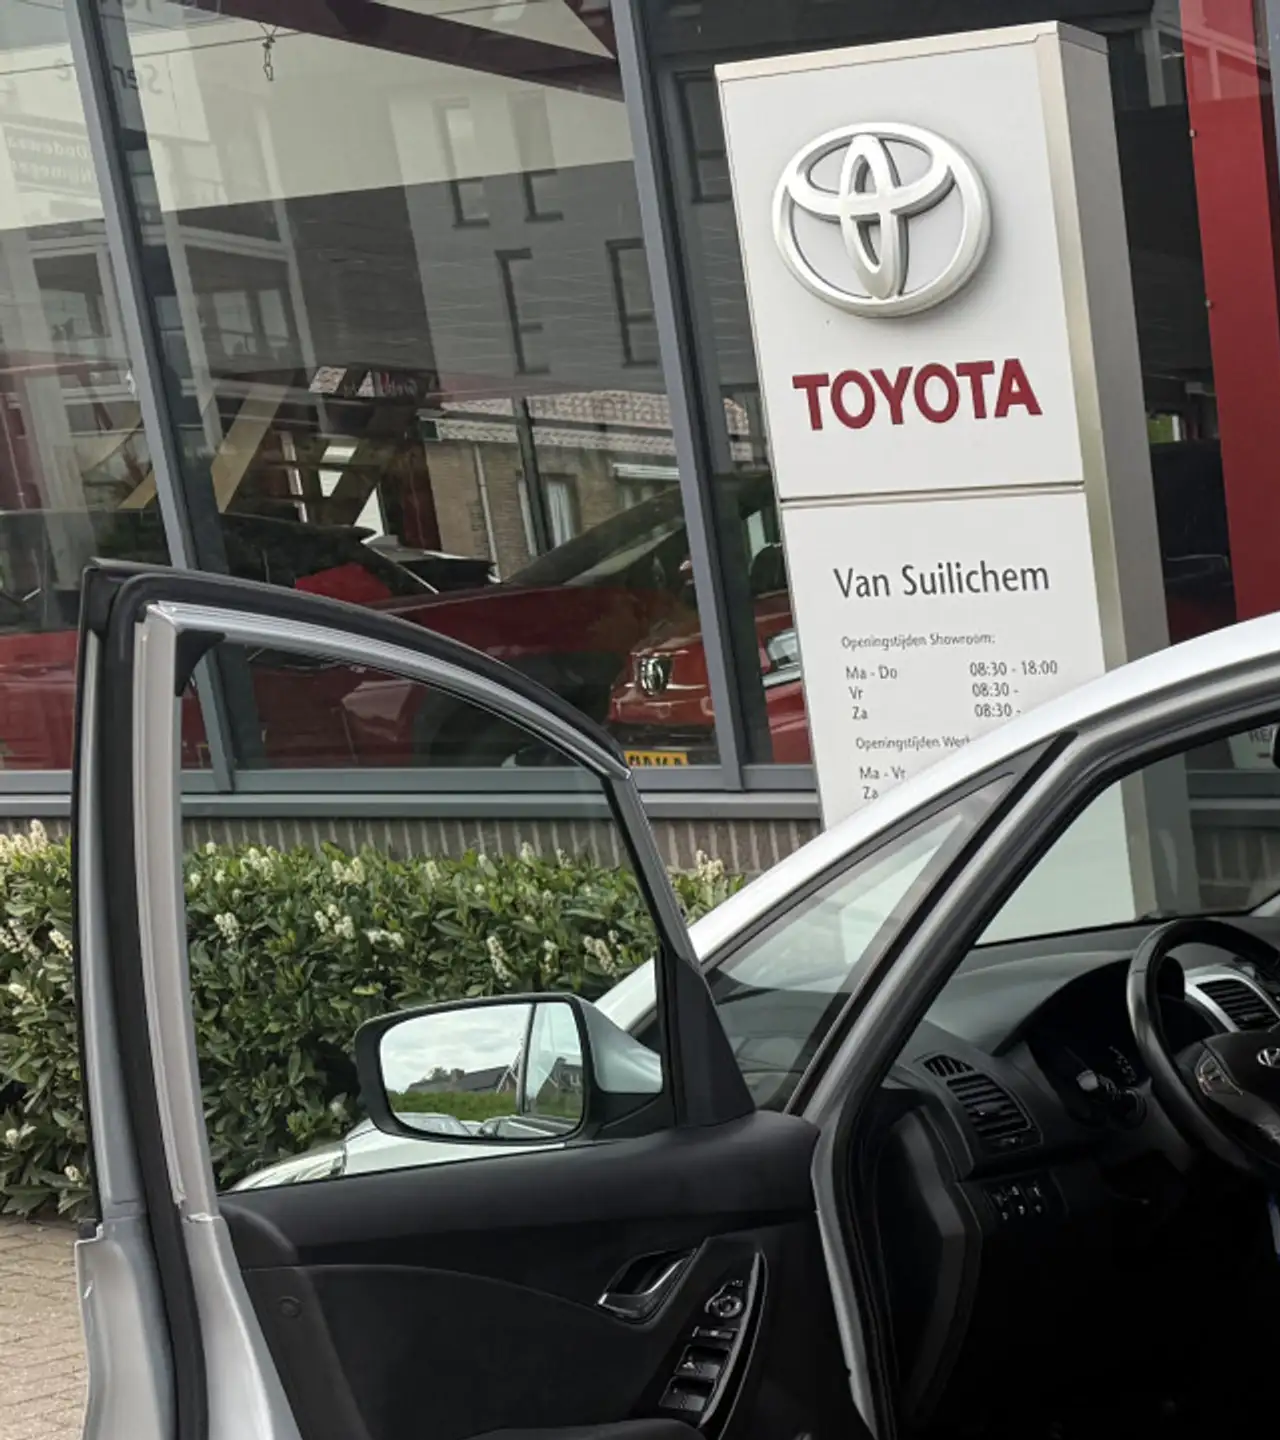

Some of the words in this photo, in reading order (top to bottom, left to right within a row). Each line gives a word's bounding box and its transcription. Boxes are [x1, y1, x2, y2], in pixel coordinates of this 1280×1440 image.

[792, 358, 1042, 431] TOYOTA
[832, 567, 891, 599] Van
[901, 560, 1050, 597] Suilichem
[841, 634, 927, 651] Openingstijden
[846, 665, 868, 681] Ma
[878, 664, 898, 680] Do
[969, 661, 1008, 677] 08:30
[1021, 659, 1058, 676] 18:00
[849, 685, 864, 700] Vr
[972, 681, 1010, 698] 08:30
[852, 706, 868, 720] Za
[974, 702, 1012, 718] 08:30
[855, 735, 941, 752] Openingstijden
[859, 766, 880, 780] Ma
[863, 786, 879, 800] Za
